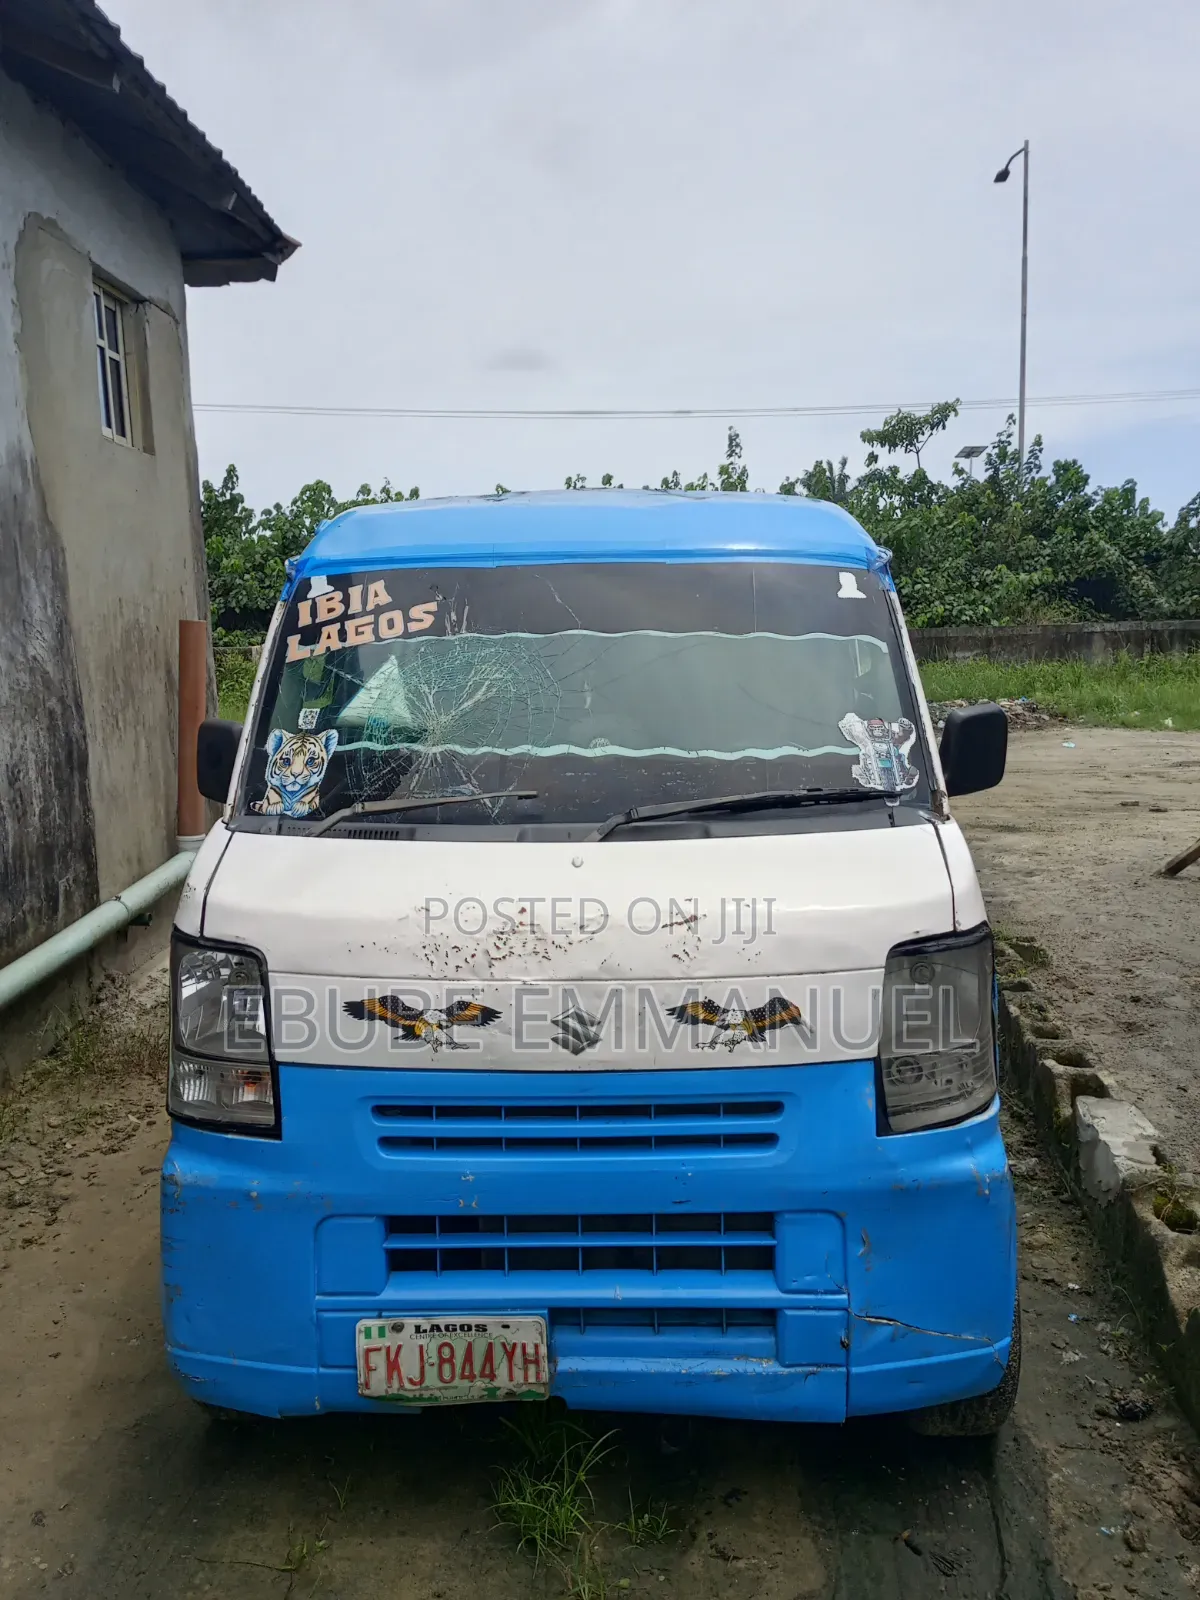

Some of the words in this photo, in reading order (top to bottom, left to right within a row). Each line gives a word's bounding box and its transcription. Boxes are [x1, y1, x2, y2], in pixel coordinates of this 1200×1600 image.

[297, 579, 393, 628] IBIA
[285, 600, 438, 663] LAGOS
[409, 1332, 437, 1340] CENTRE
[450, 1331, 493, 1339] EXCELLENCE
[414, 1323, 488, 1334] LAGOS
